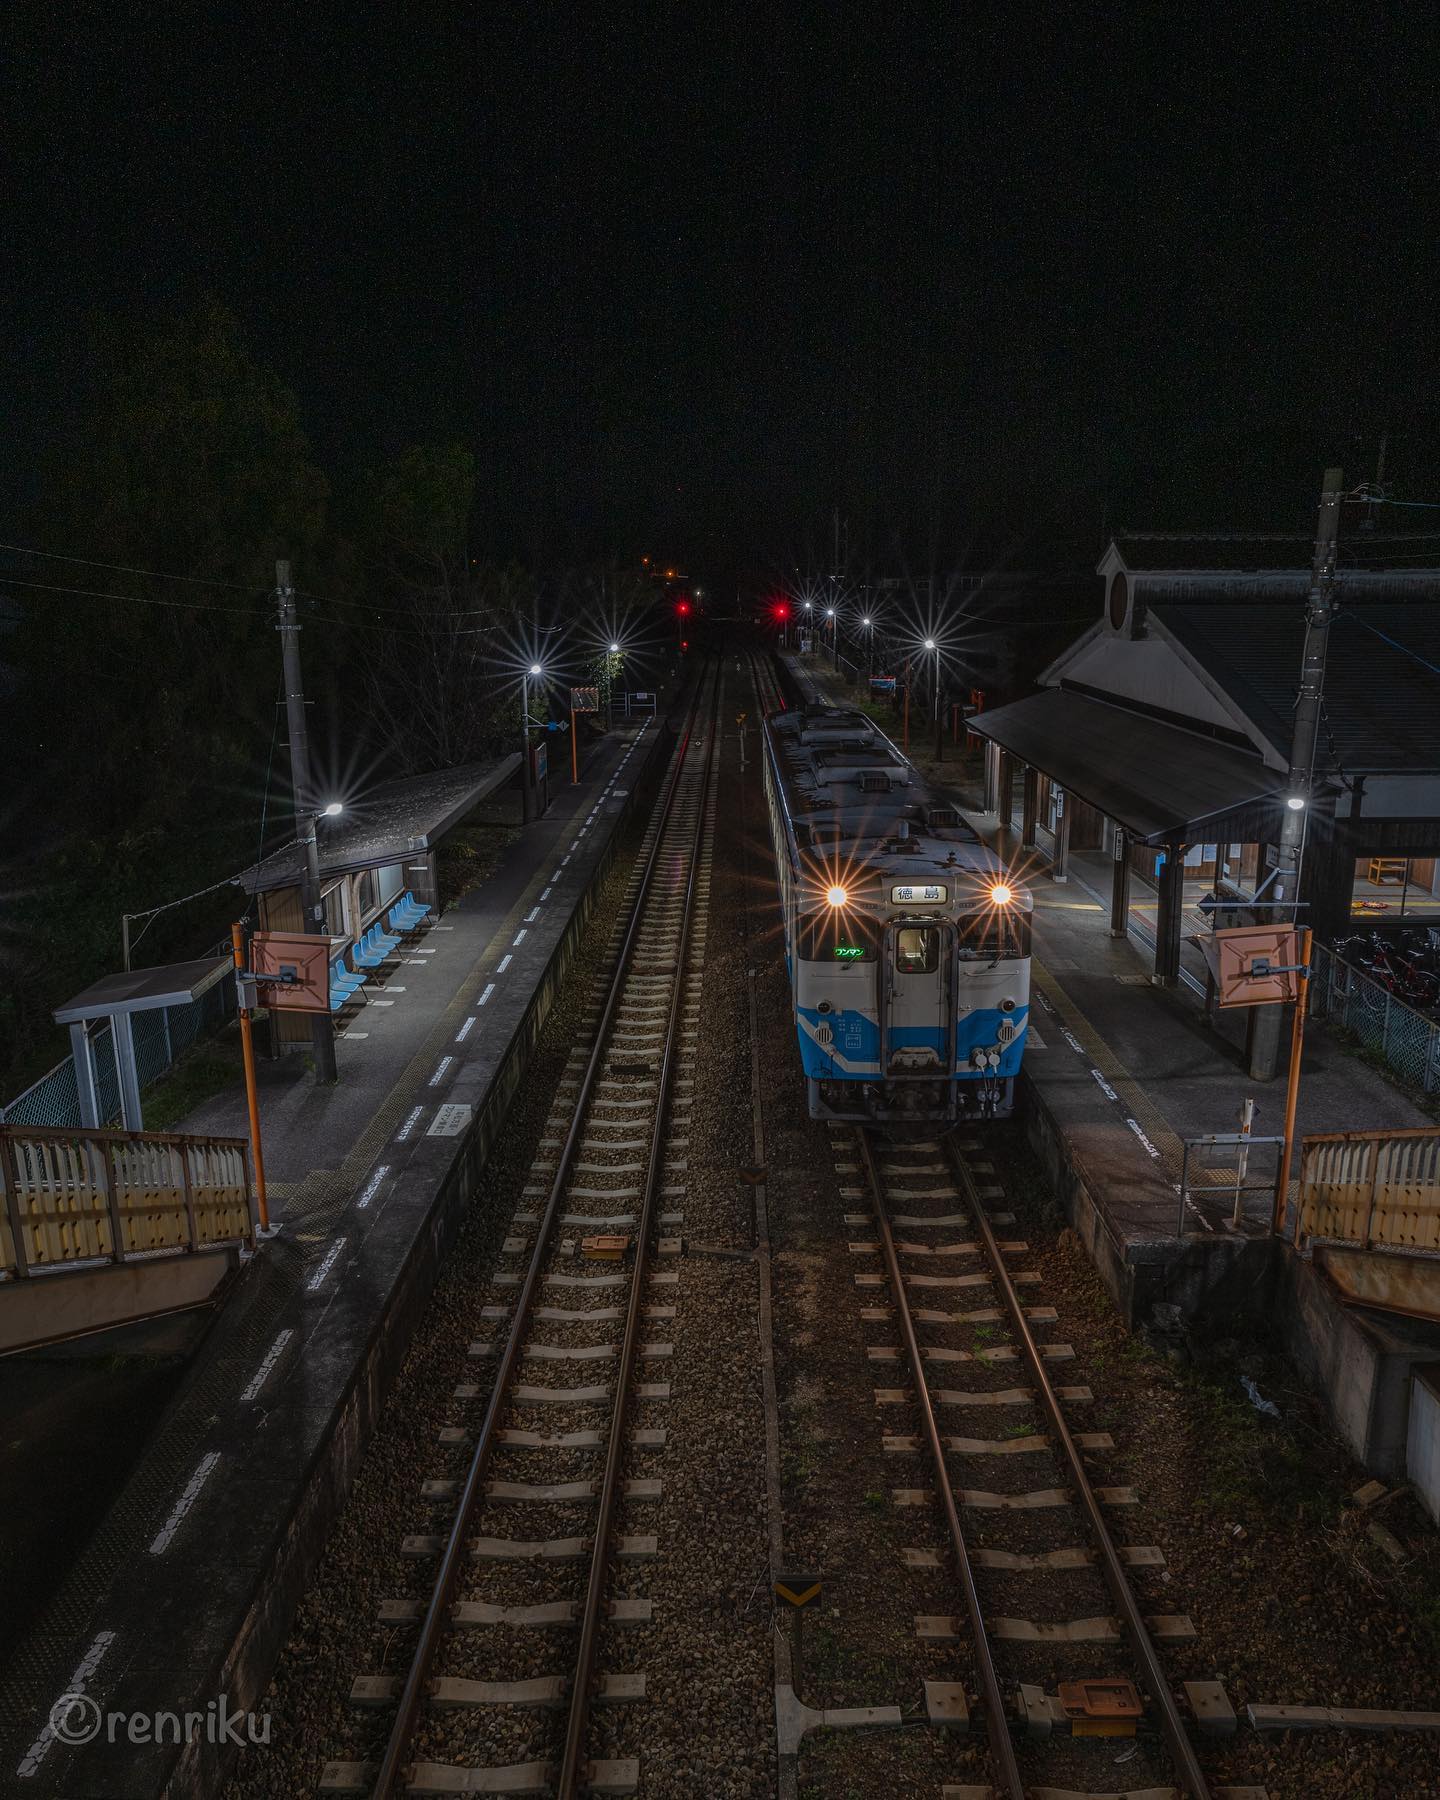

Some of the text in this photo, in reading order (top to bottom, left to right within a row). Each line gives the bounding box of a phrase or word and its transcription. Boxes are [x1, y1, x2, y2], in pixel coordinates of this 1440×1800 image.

[898, 886, 940, 900] 徳島
[835, 948, 864, 956] ワンマン
